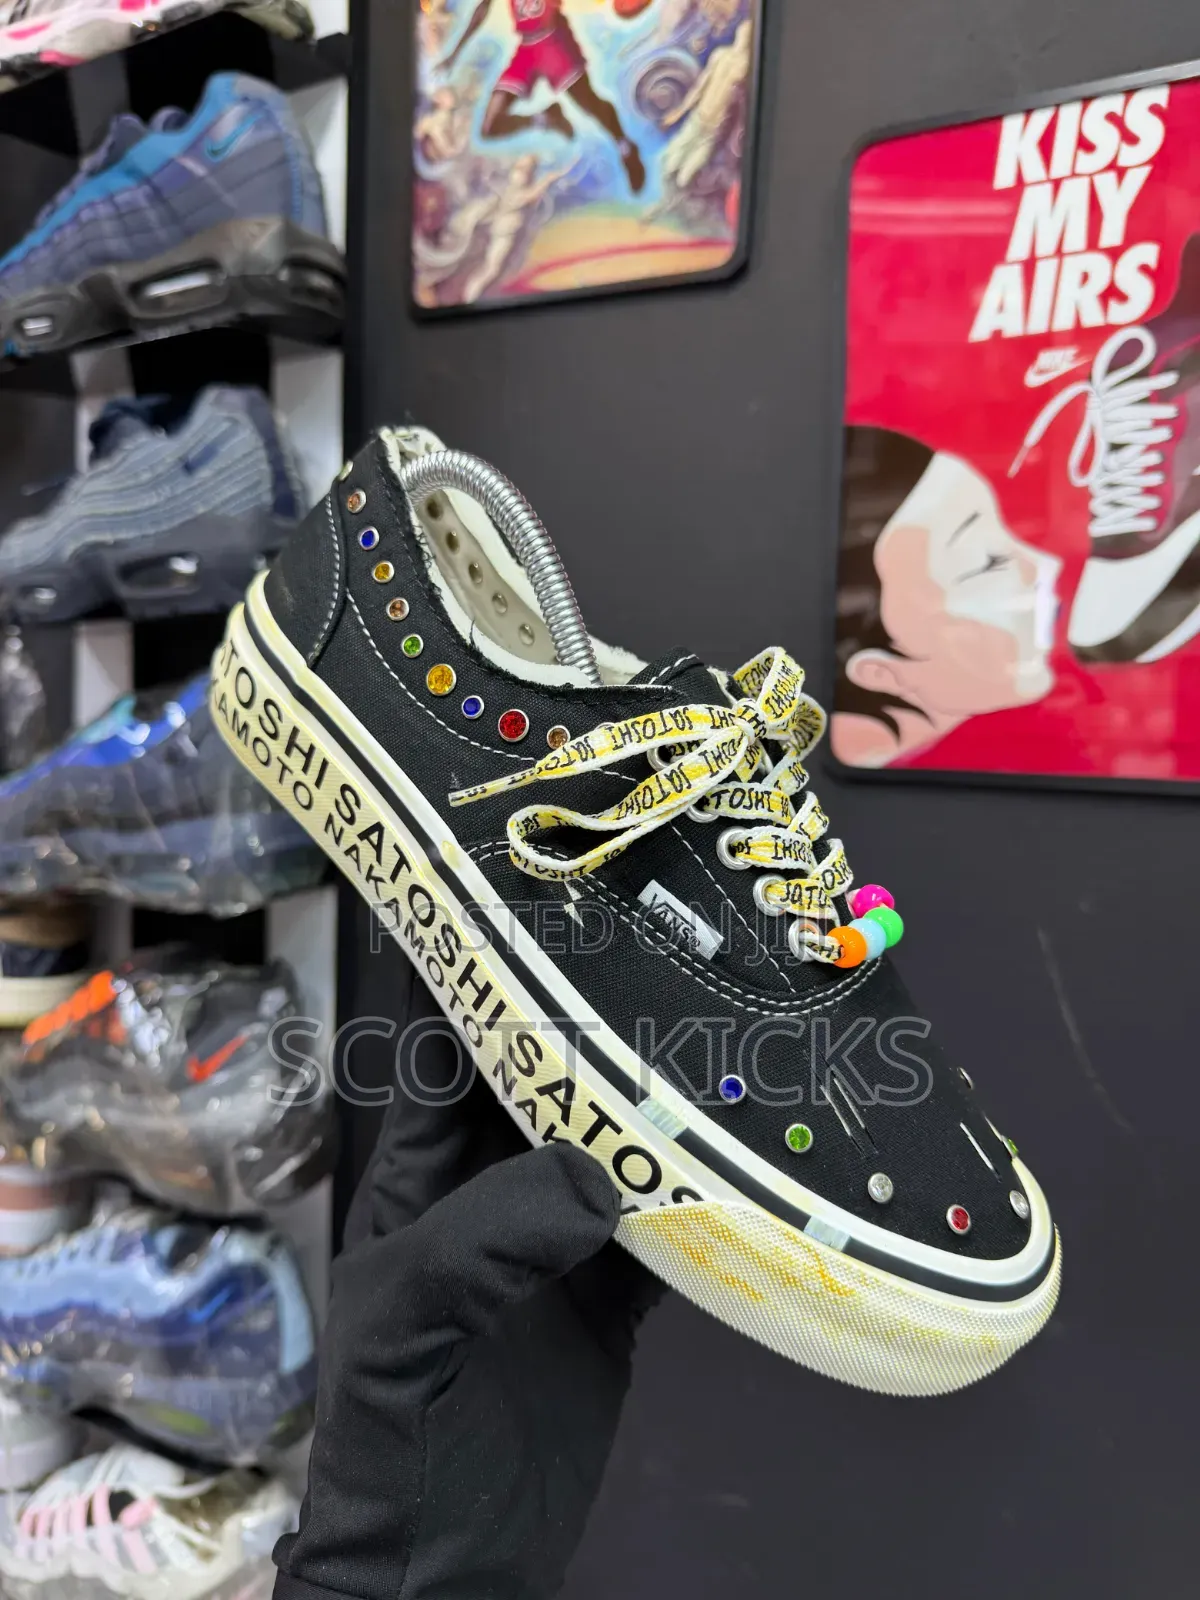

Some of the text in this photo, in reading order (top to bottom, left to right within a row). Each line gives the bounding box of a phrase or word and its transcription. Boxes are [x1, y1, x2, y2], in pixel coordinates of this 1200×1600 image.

[993, 84, 1170, 190] KISS
[1005, 165, 1153, 263] MY
[968, 242, 1160, 343] AIRS
[216, 686, 314, 811] AMOTO
[221, 638, 329, 789] TOSHI
[325, 813, 483, 1049] NAKAMOTO
[335, 784, 507, 1031] SATOSHI
